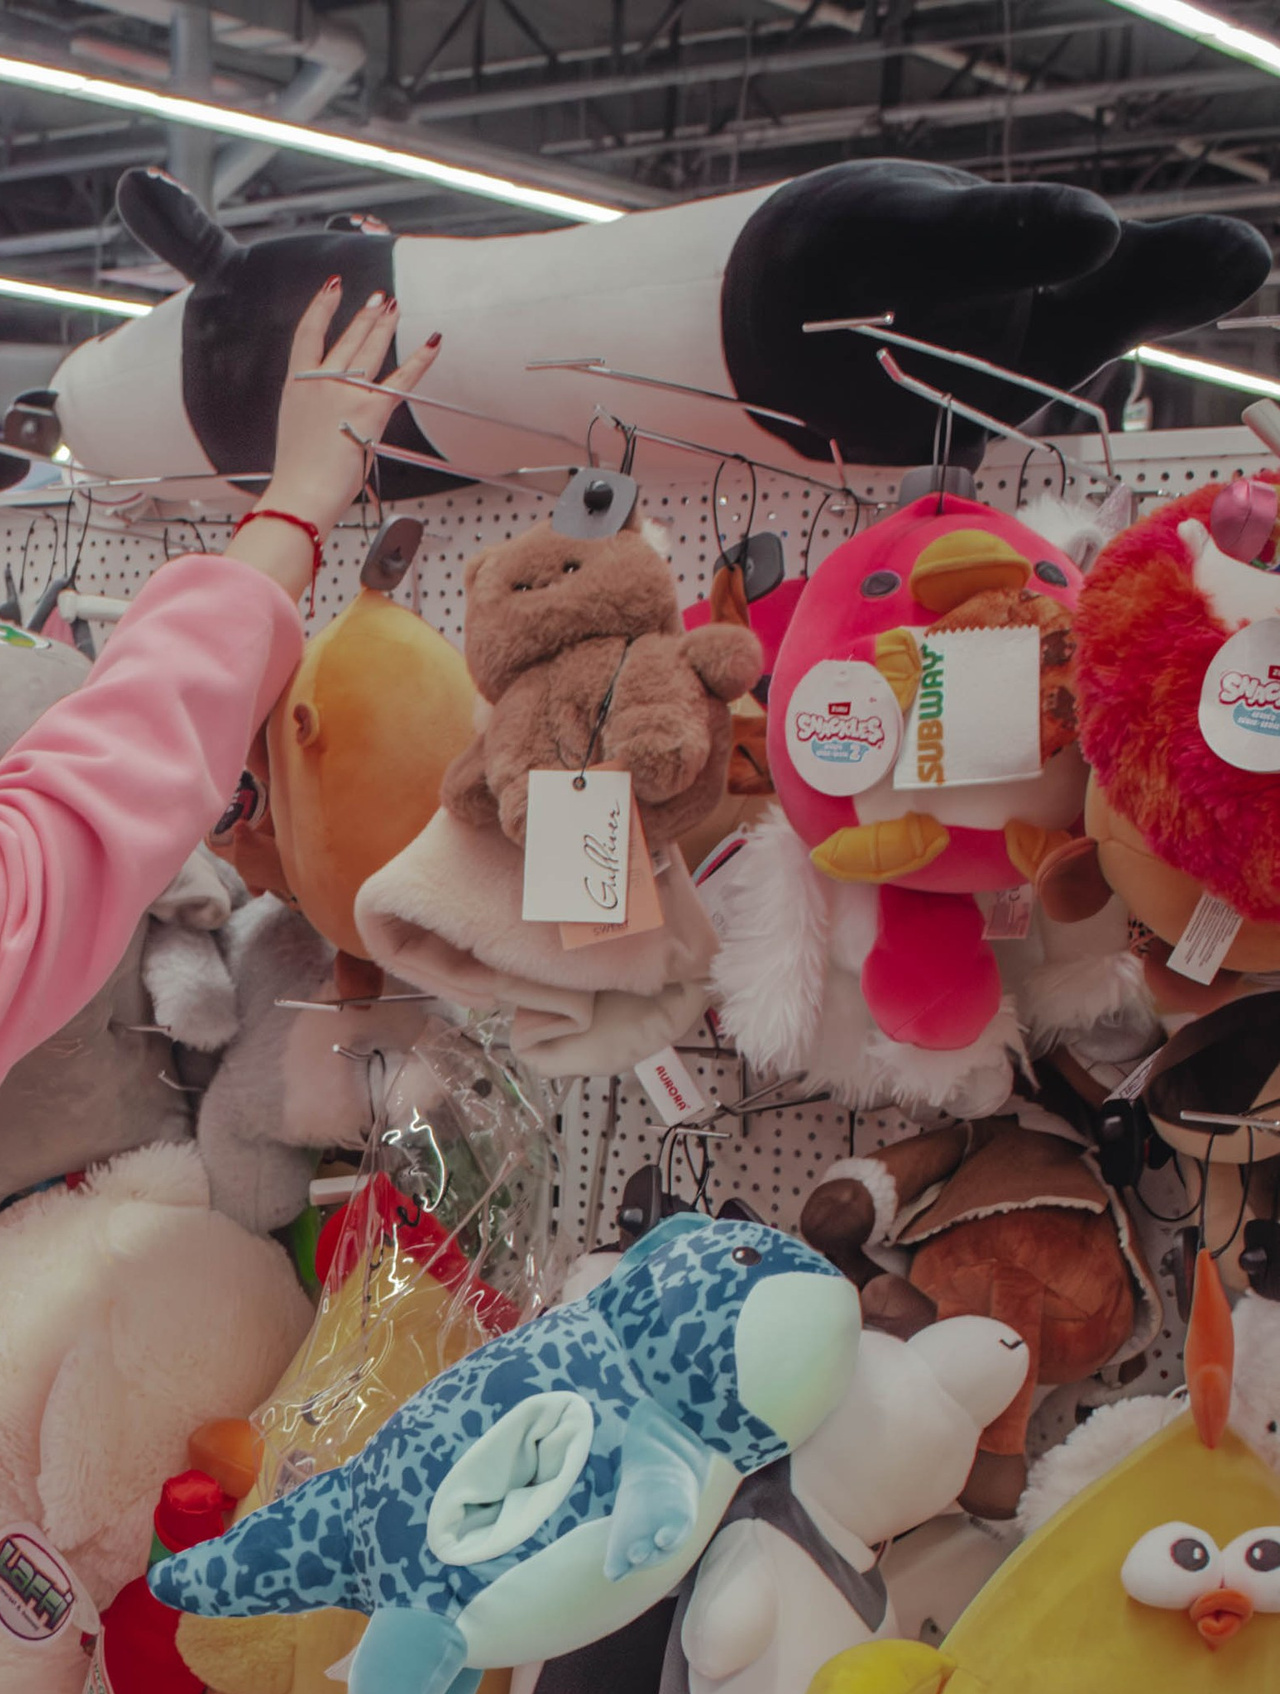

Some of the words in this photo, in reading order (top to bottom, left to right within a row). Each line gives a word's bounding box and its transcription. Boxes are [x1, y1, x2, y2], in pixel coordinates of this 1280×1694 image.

[916, 642, 946, 786] SUBWAY
[583, 799, 621, 910] Gulliver
[655, 1065, 688, 1111] AURORA
